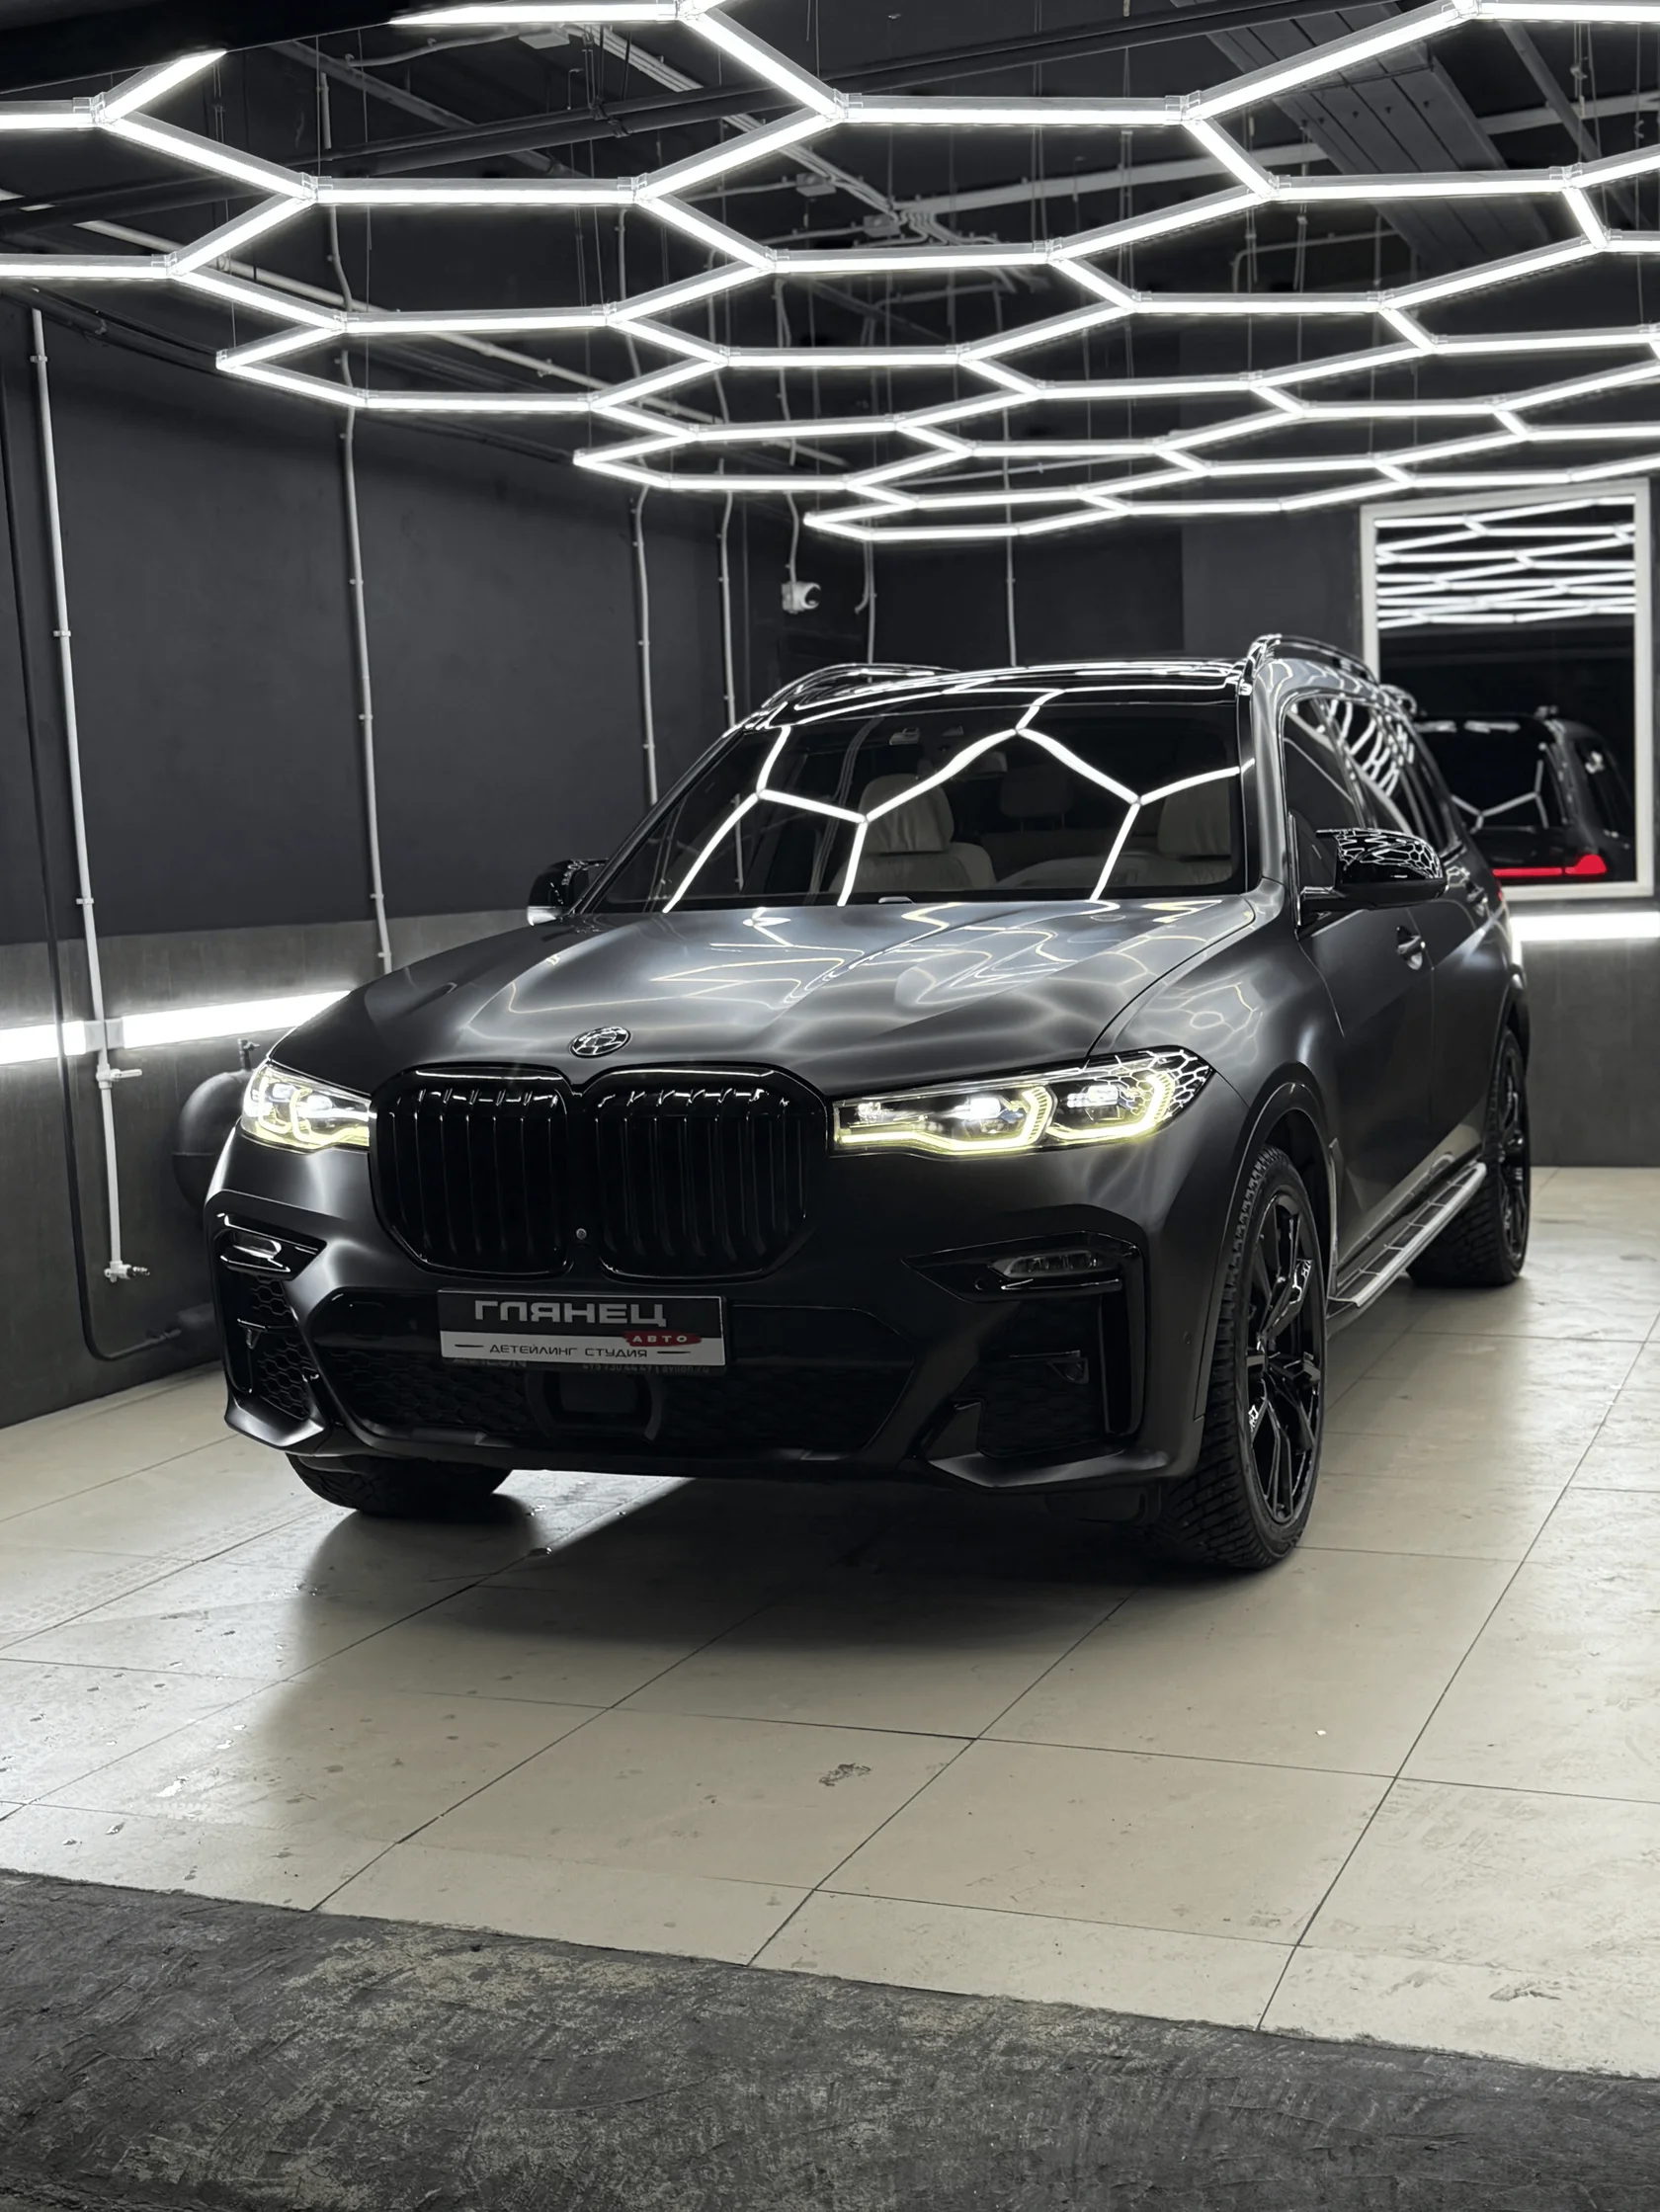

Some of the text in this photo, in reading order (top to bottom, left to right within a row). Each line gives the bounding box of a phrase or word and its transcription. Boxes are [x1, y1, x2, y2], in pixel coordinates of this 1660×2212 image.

[474, 1299, 667, 1328] ГЛЯНЕЦ
[632, 1335, 688, 1344] АВТО
[489, 1344, 648, 1358] ДЕТЕЙЛИНГ СТУДИЯ
